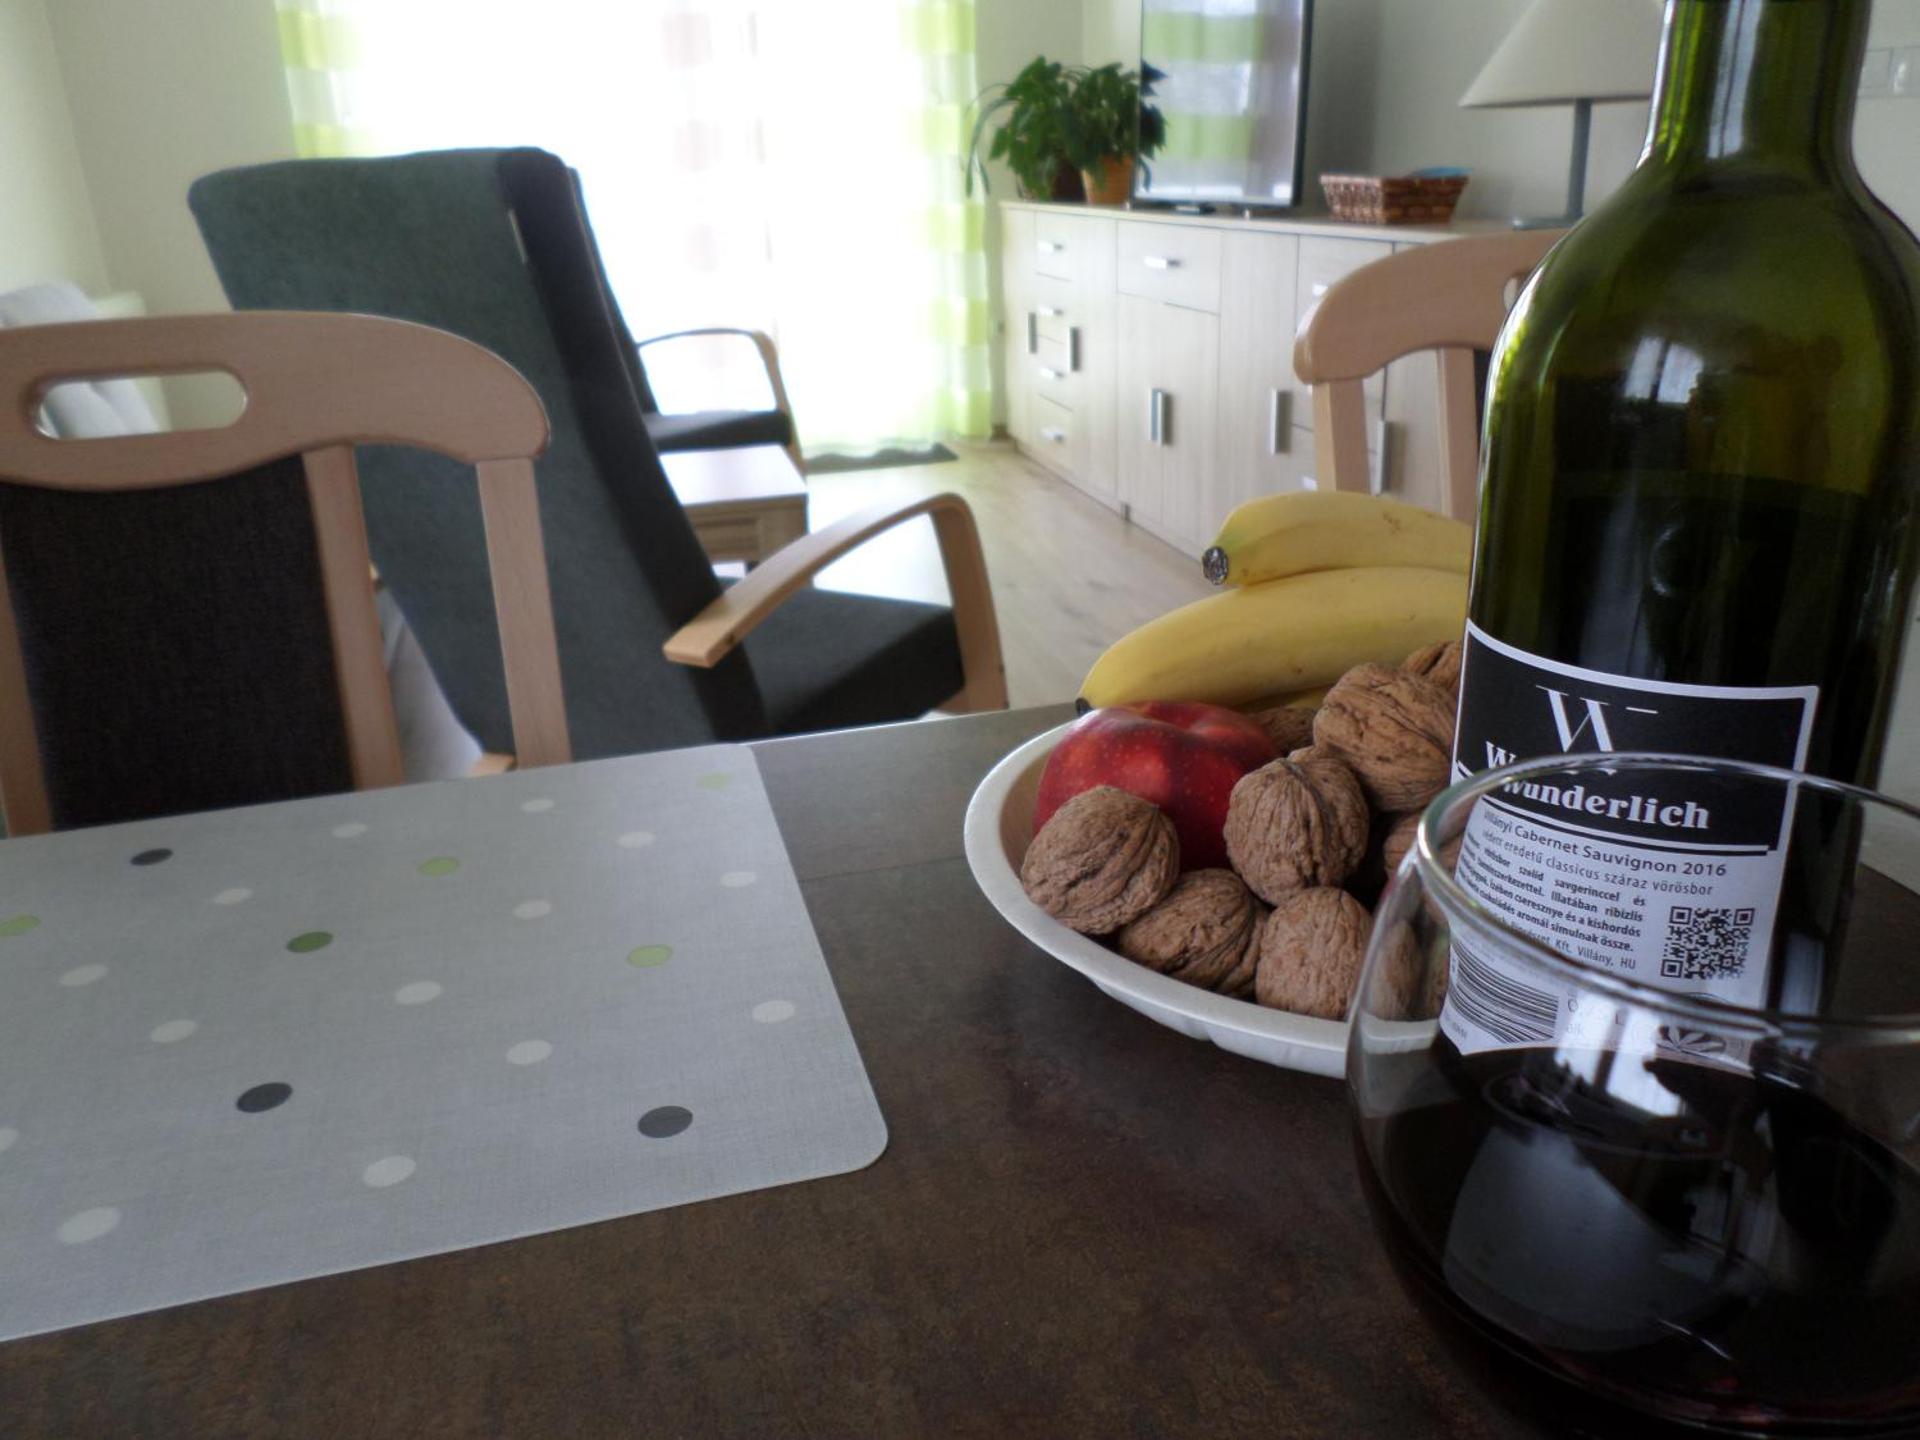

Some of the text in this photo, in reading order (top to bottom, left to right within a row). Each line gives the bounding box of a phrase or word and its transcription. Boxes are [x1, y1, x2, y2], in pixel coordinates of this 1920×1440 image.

[1515, 825, 1579, 854] Cabernet
[1582, 845, 1677, 874] Sauvignon
[1682, 862, 1727, 877] 2016
[1546, 856, 1600, 881] classicus
[1604, 871, 1649, 889] száraz
[1652, 880, 1714, 896] vörösbor
[1554, 878, 1620, 902] savgerinccel
[1632, 895, 1646, 907] és
[1565, 911, 1577, 922] és
[1587, 916, 1641, 937] kishordós
[1604, 907, 1643, 922] ribizlis
[1550, 922, 1599, 945] simulnak
[1600, 937, 1634, 951] össze.
[1577, 945, 1615, 967] Villány,
[1620, 956, 1637, 969] HU
